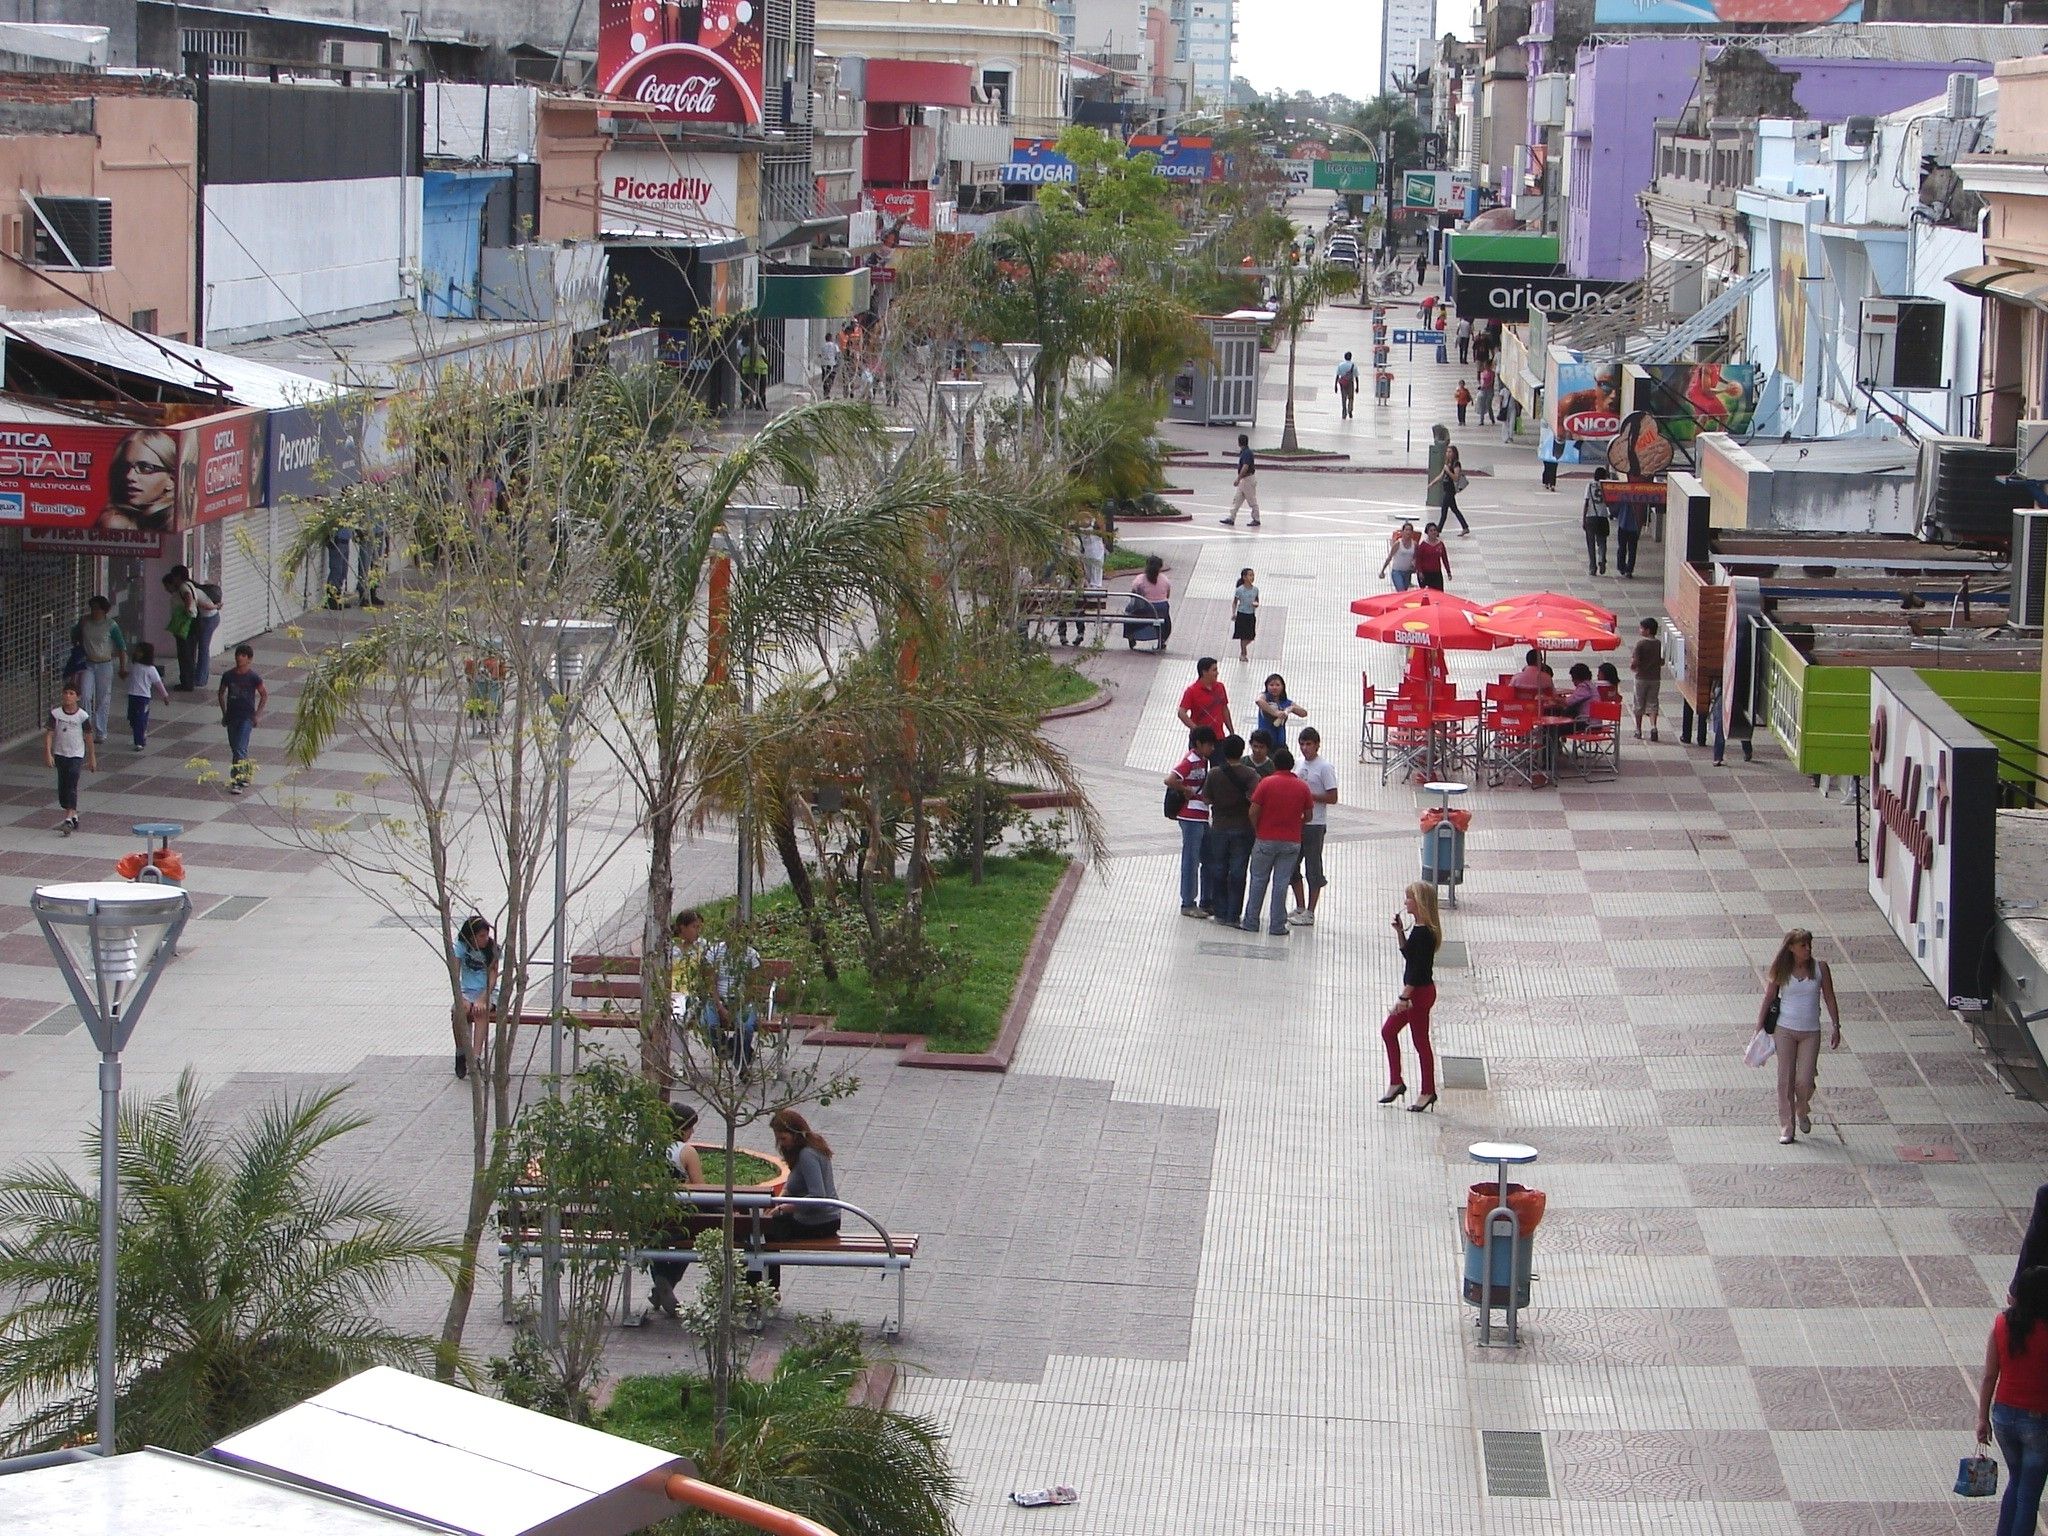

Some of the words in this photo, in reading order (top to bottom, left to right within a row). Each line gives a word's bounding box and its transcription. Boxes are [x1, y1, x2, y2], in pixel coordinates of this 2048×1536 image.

[614, 176, 712, 205] Piccadilly
[1574, 417, 1620, 433] NICO
[278, 423, 321, 473] Personal
[1395, 630, 1431, 646] BRAHMA
